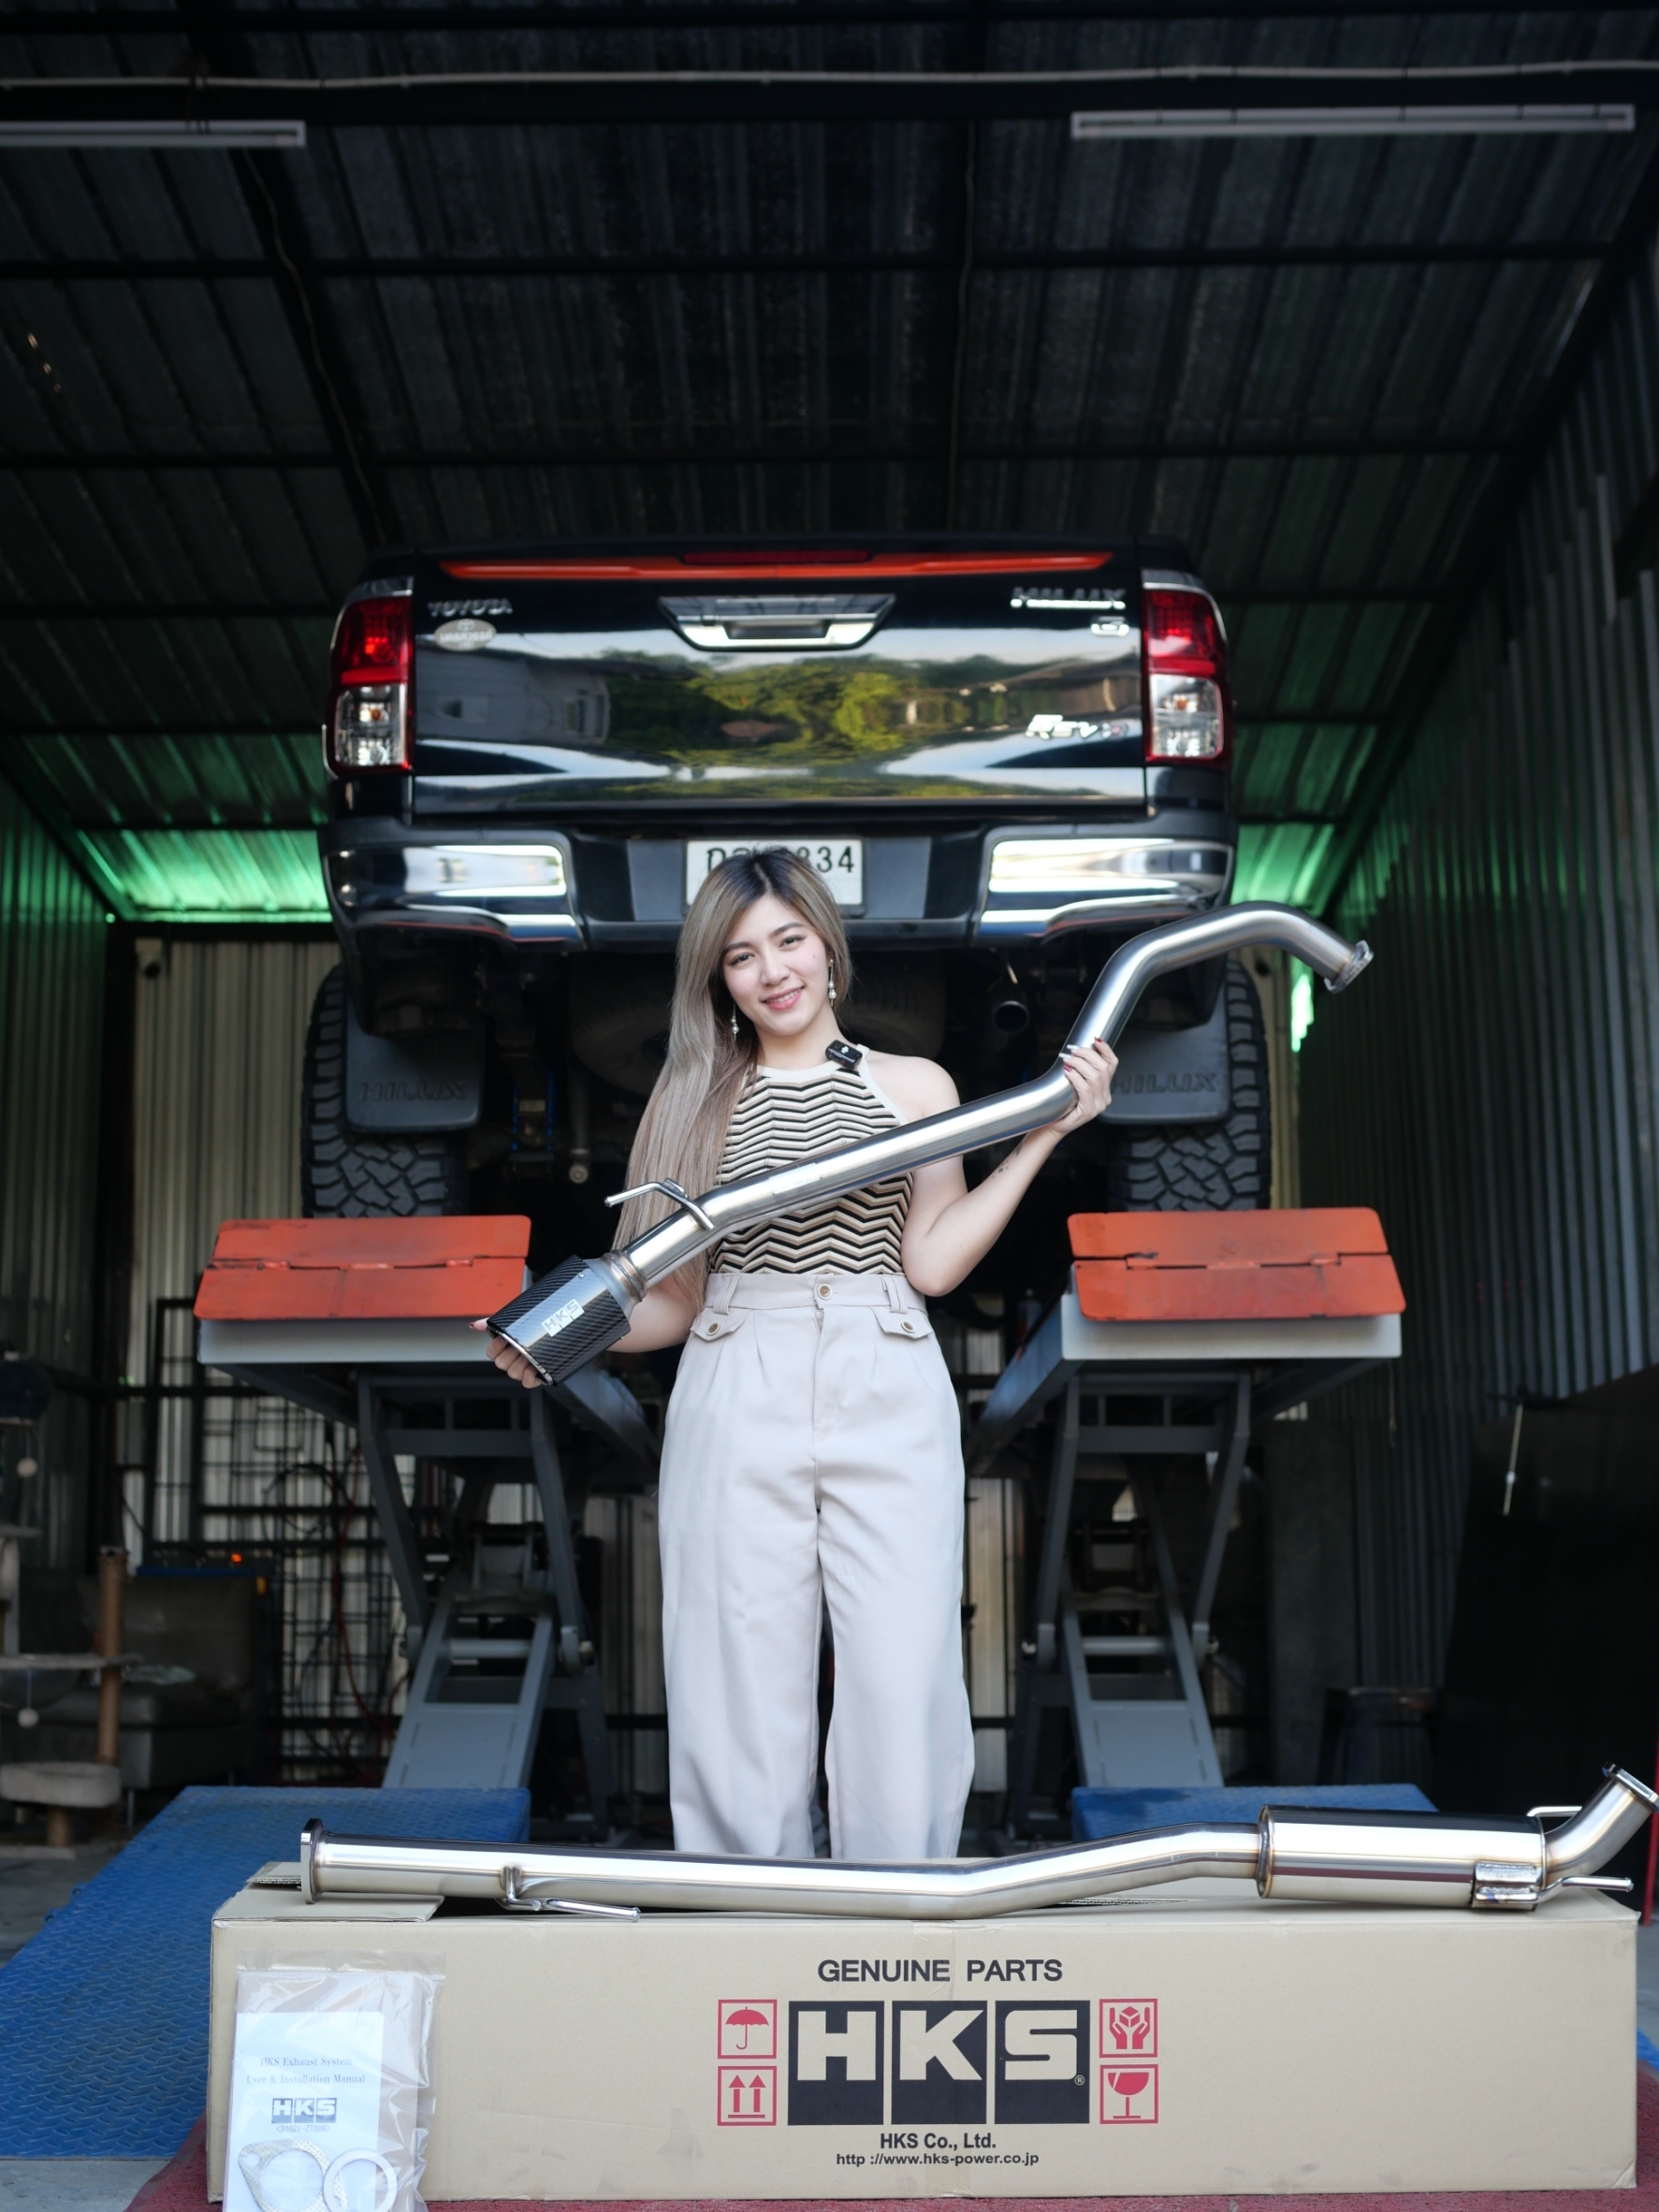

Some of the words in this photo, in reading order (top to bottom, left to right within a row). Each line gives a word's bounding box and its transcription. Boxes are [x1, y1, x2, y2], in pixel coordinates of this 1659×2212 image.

[428, 598, 514, 617] TOYOTA
[357, 1080, 467, 1103] HILUX
[542, 1300, 584, 1335] HKS
[817, 1958, 951, 1983] GENUINE
[967, 1958, 1063, 1982] PARTS
[795, 2008, 1084, 2087] HKS
[260, 2058, 280, 2066] HKS
[283, 2057, 318, 2066] Exhaust
[321, 2057, 353, 2069] System
[246, 2074, 267, 2084] User
[269, 2074, 277, 2084] &
[280, 2074, 330, 2084] Installation
[333, 2074, 366, 2083] Manual
[272, 2098, 337, 2119] HKS
[880, 2132, 919, 2149] HKS
[924, 2132, 958, 2151] Co.,
[964, 2132, 997, 2148] Ltd.
